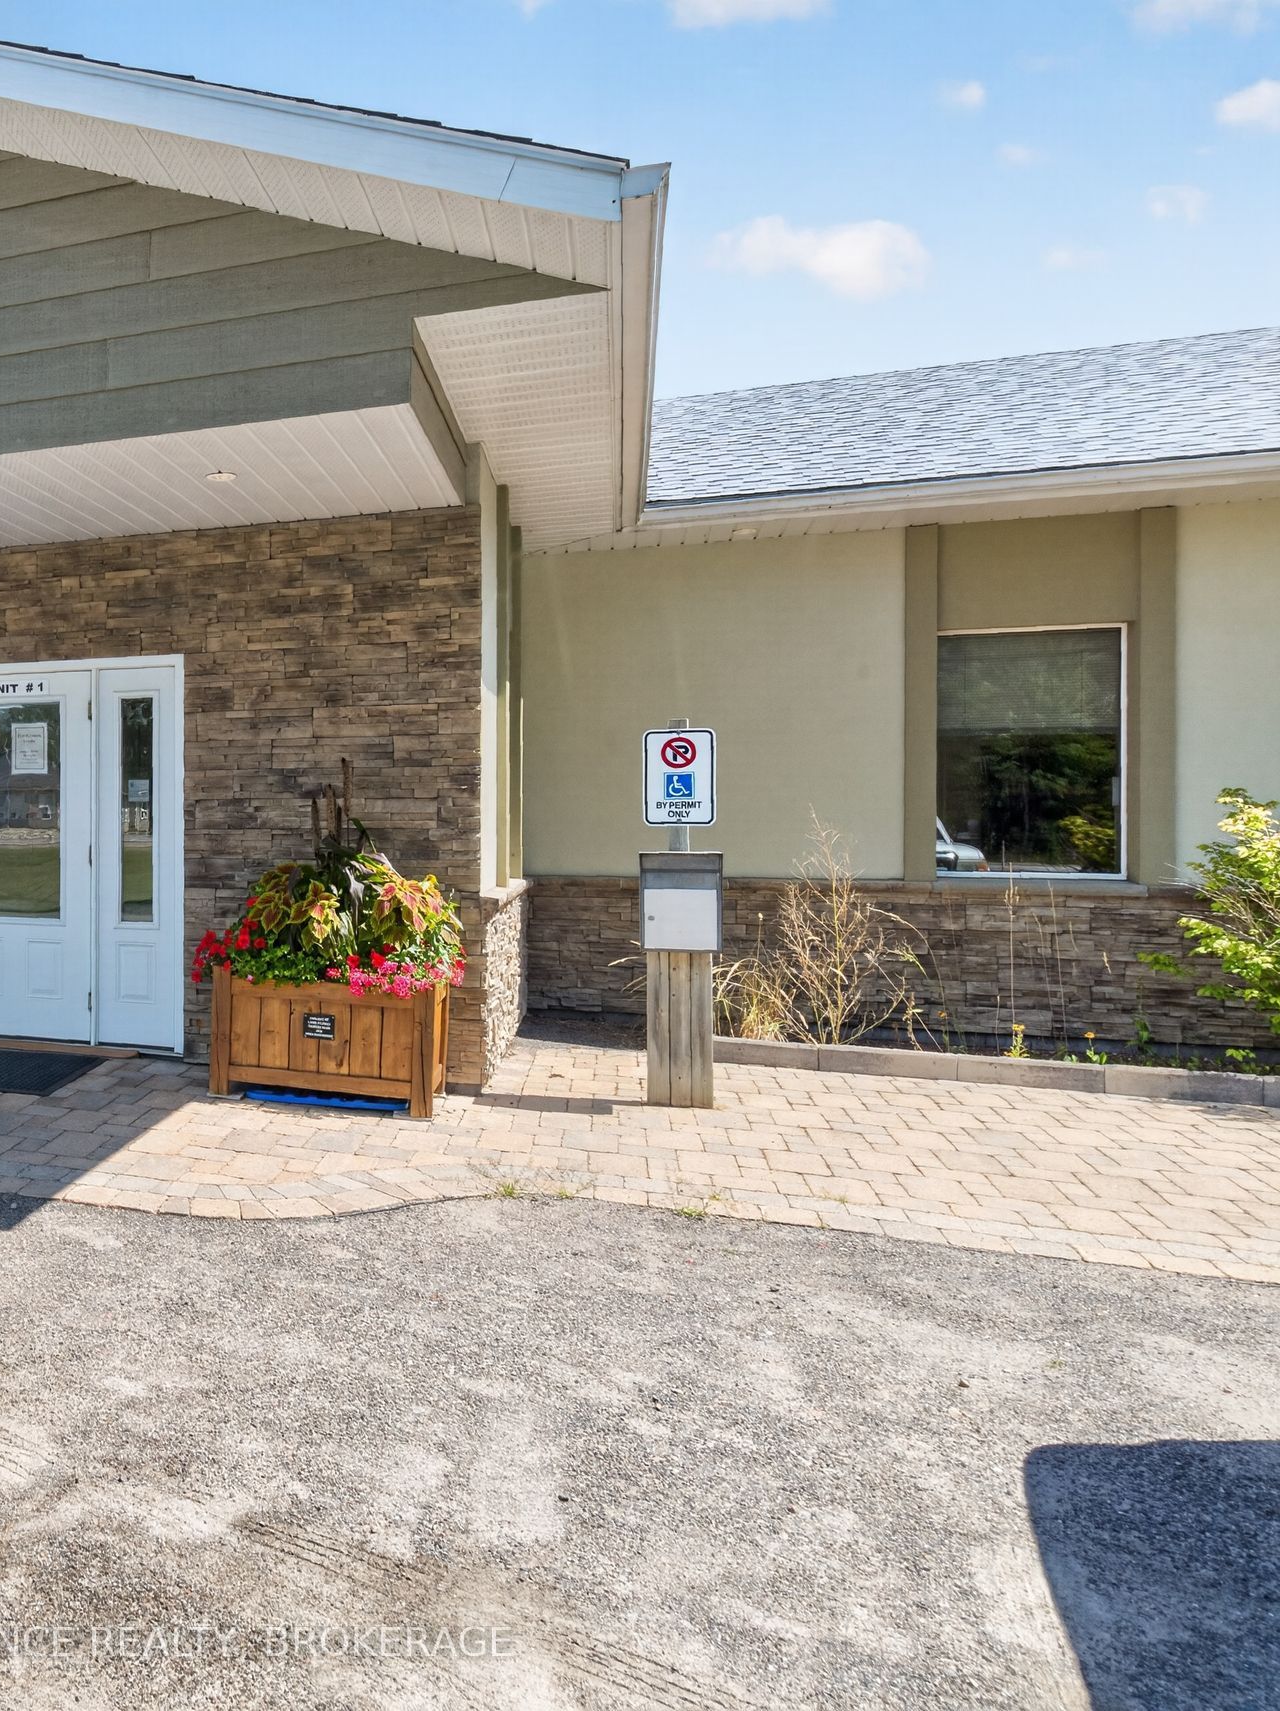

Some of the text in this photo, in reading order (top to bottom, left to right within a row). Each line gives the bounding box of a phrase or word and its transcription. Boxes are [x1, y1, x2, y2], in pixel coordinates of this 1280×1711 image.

[656, 801, 702, 809] BY PERMIT
[668, 810, 690, 818] ONLY
